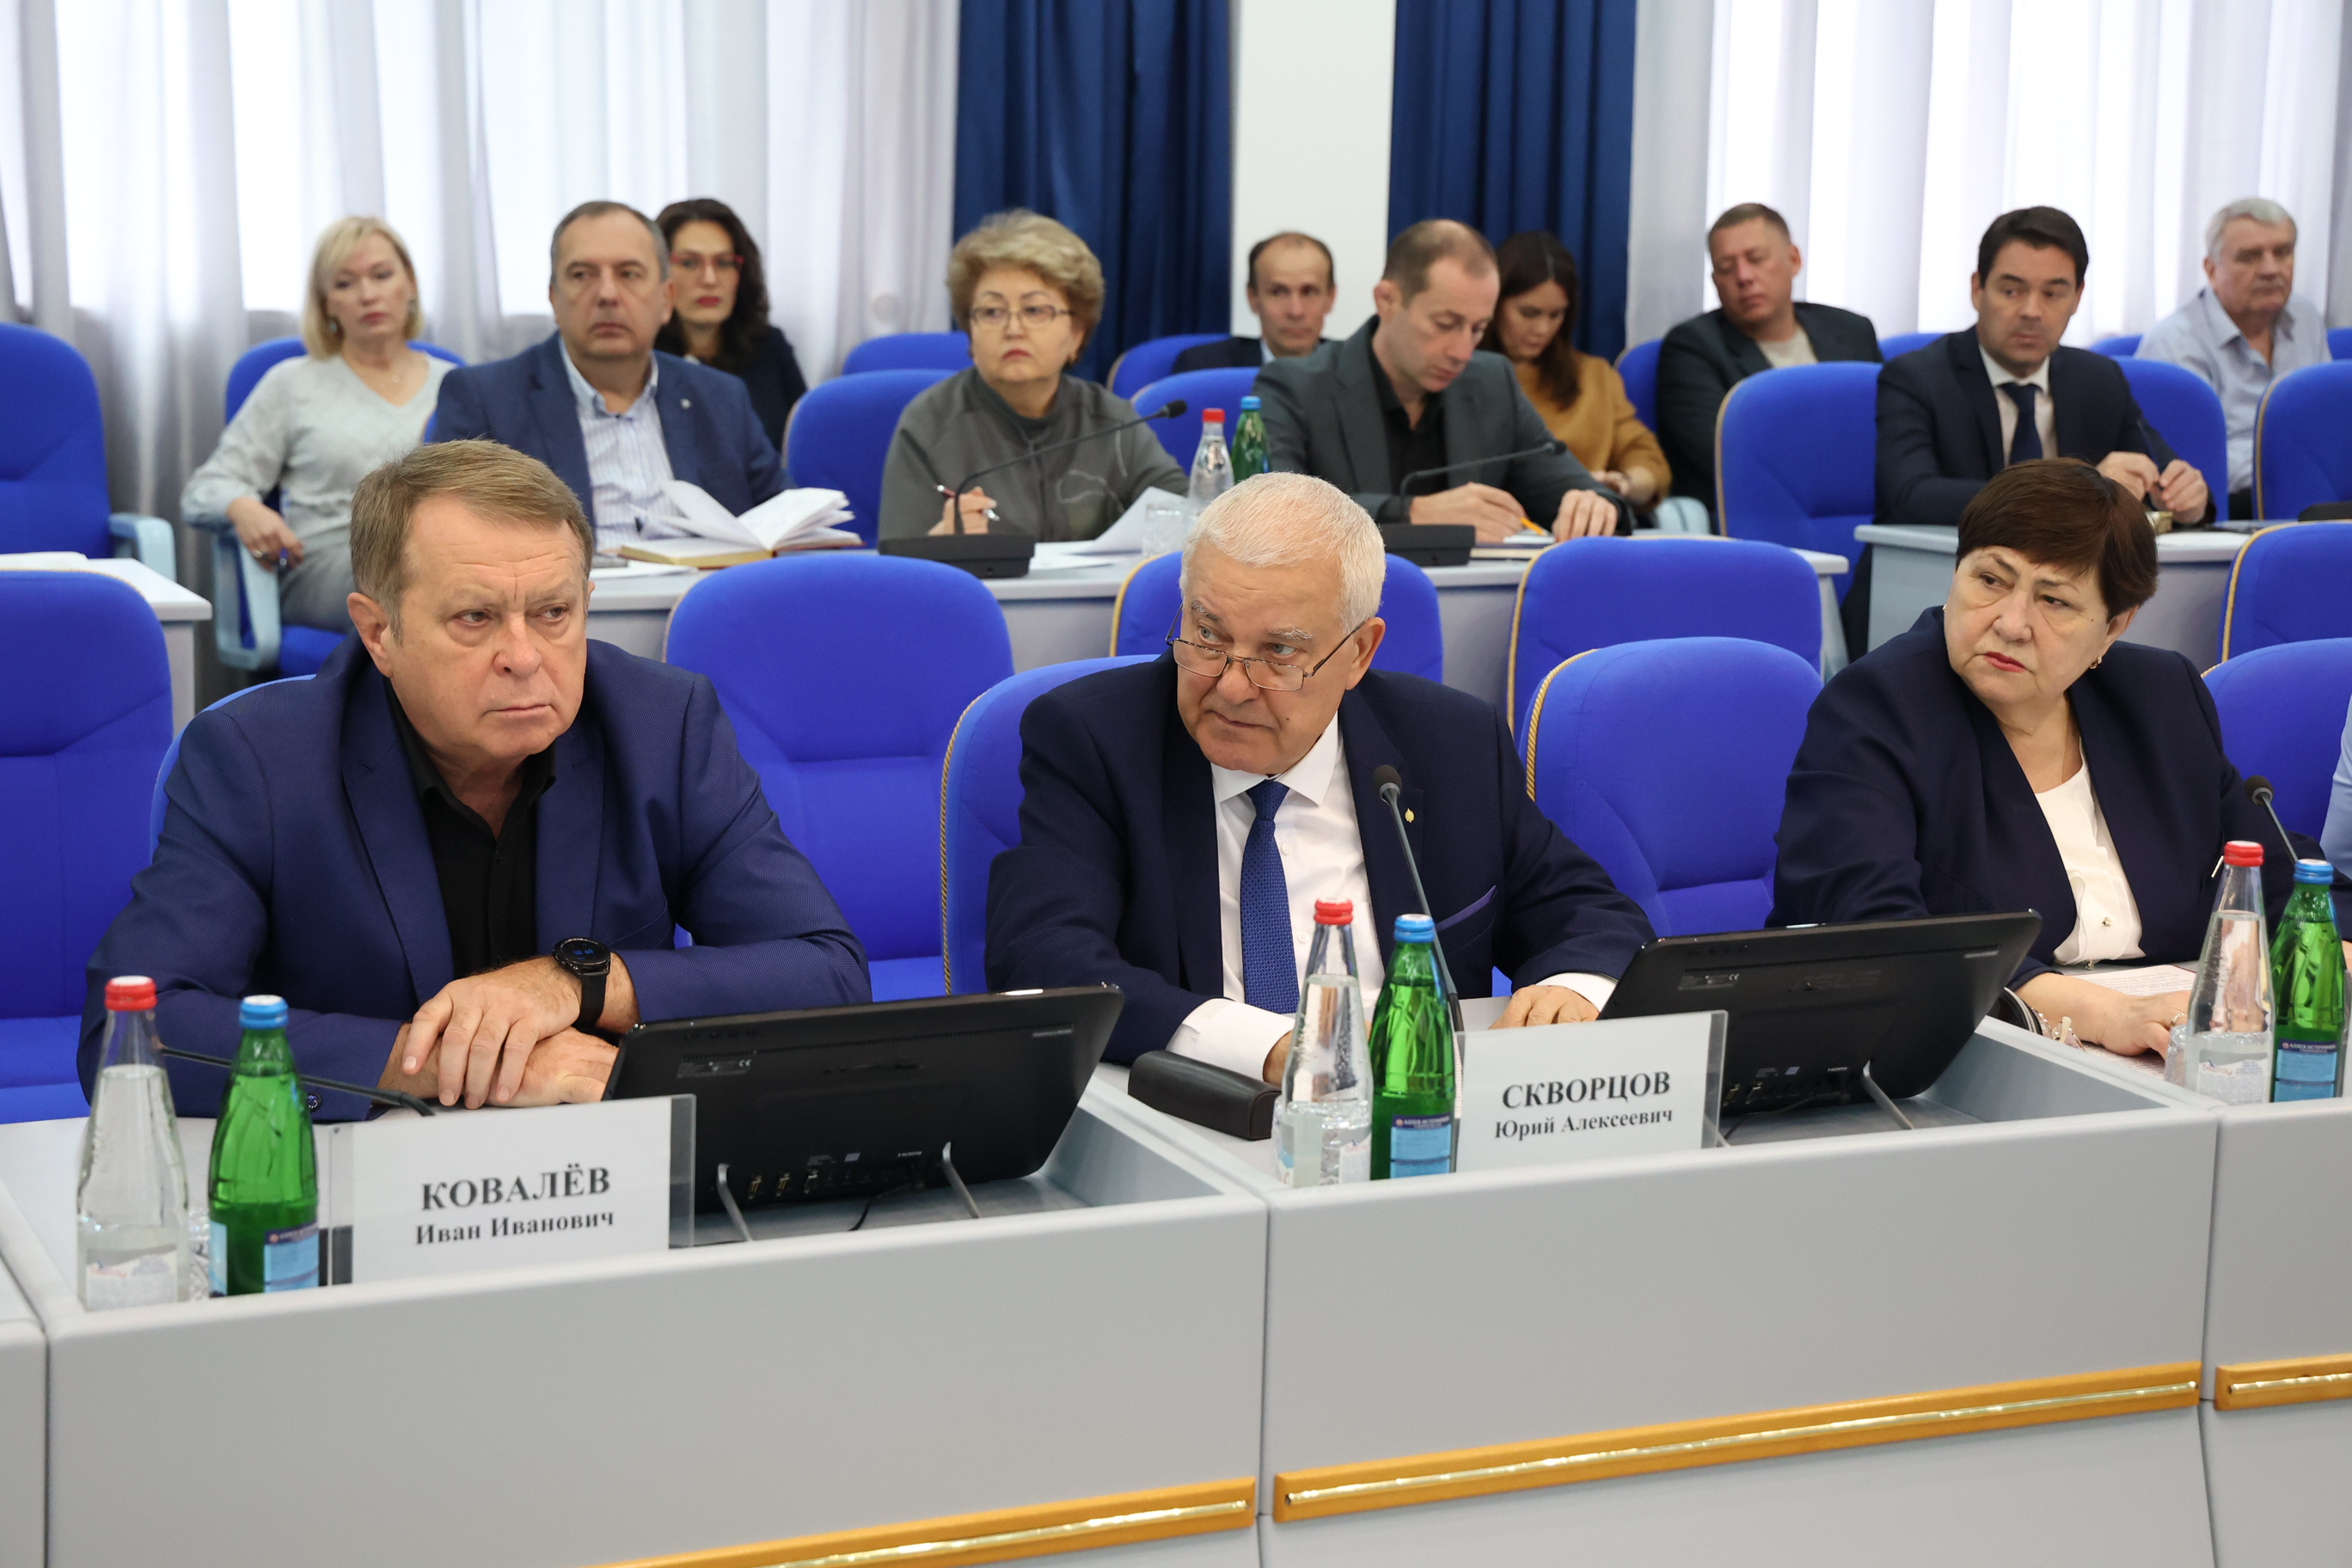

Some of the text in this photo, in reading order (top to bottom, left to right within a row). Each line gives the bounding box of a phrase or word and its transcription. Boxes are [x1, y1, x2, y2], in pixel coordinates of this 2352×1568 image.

[1502, 1071, 1670, 1109] СКВОРЦОВ
[1495, 1110, 1672, 1141] Юрий Алексеевич
[422, 1163, 610, 1210] КОВАЛЁВ
[416, 1212, 614, 1244] Иван Иванович
